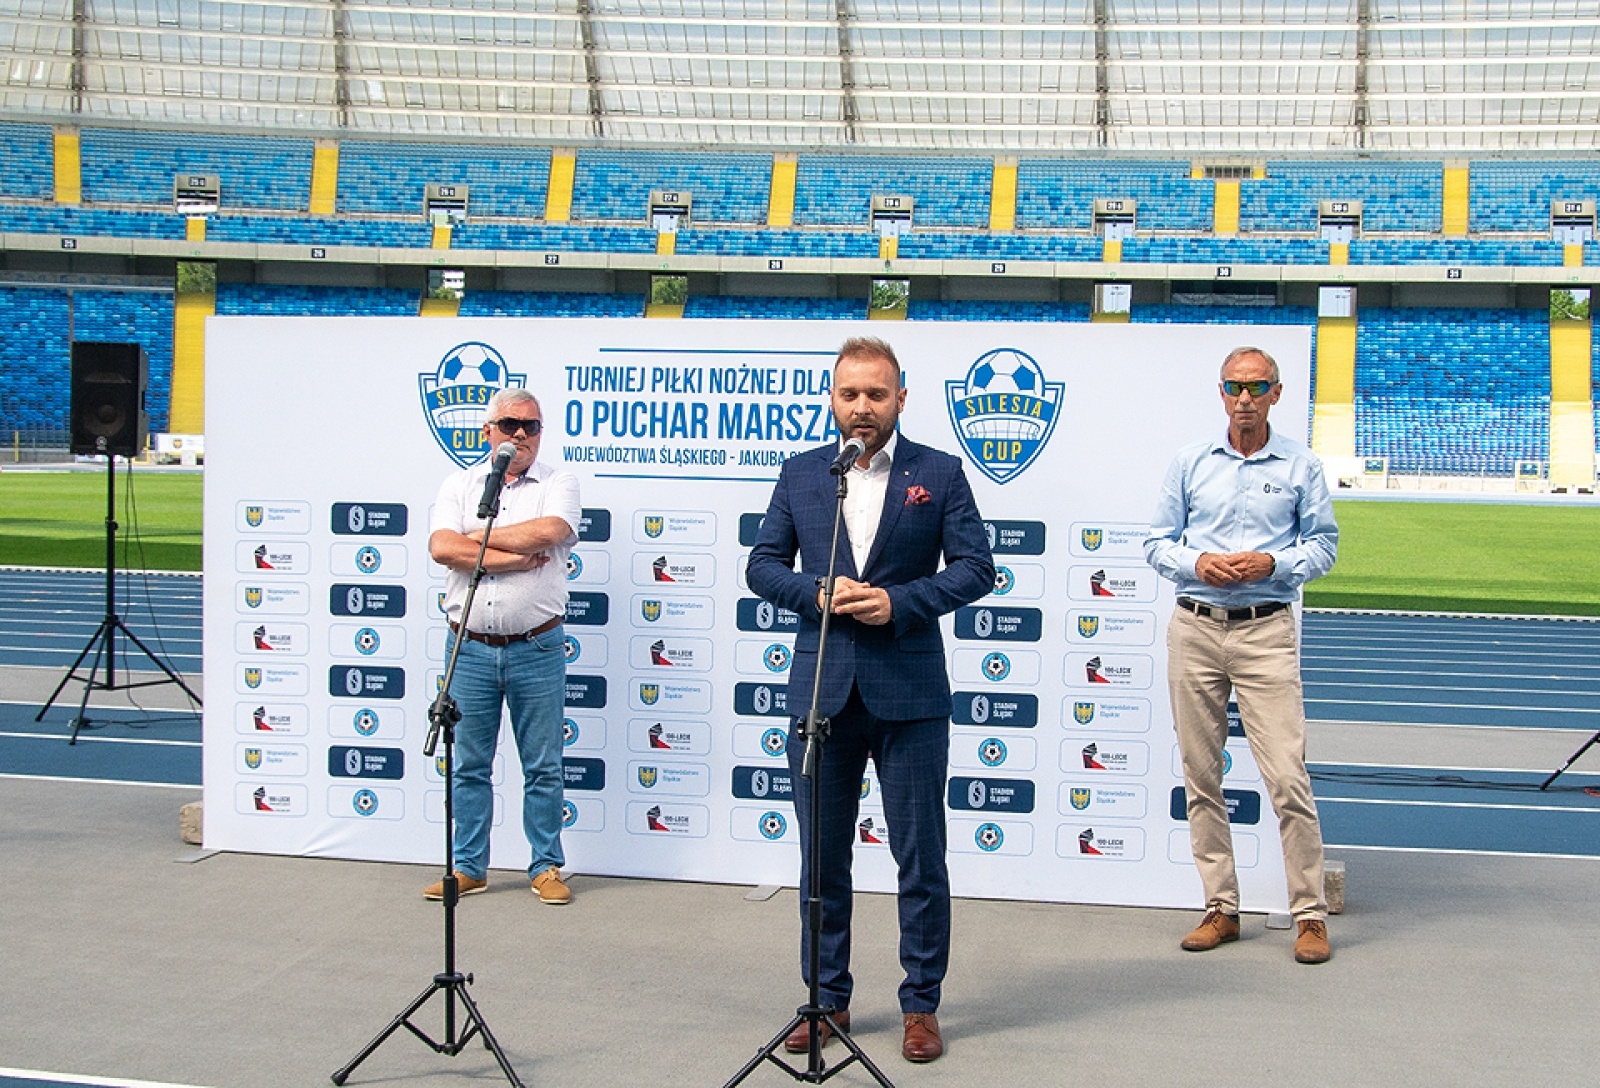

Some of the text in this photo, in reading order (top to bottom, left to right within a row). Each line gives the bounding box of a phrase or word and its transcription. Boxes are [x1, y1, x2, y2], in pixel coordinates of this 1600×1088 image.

[565, 363, 831, 395] TURNIEJ PIŁKI NOŻNEJ DLA
[965, 394, 1042, 417] SILESIA
[565, 400, 841, 442] O PUCHAR MARSZA
[564, 446, 656, 464] WOJEWÓDZTWA
[659, 444, 726, 467] ŚLĄSKIEGO
[738, 450, 787, 466] JAKUBA
[983, 441, 1022, 461] CUP
